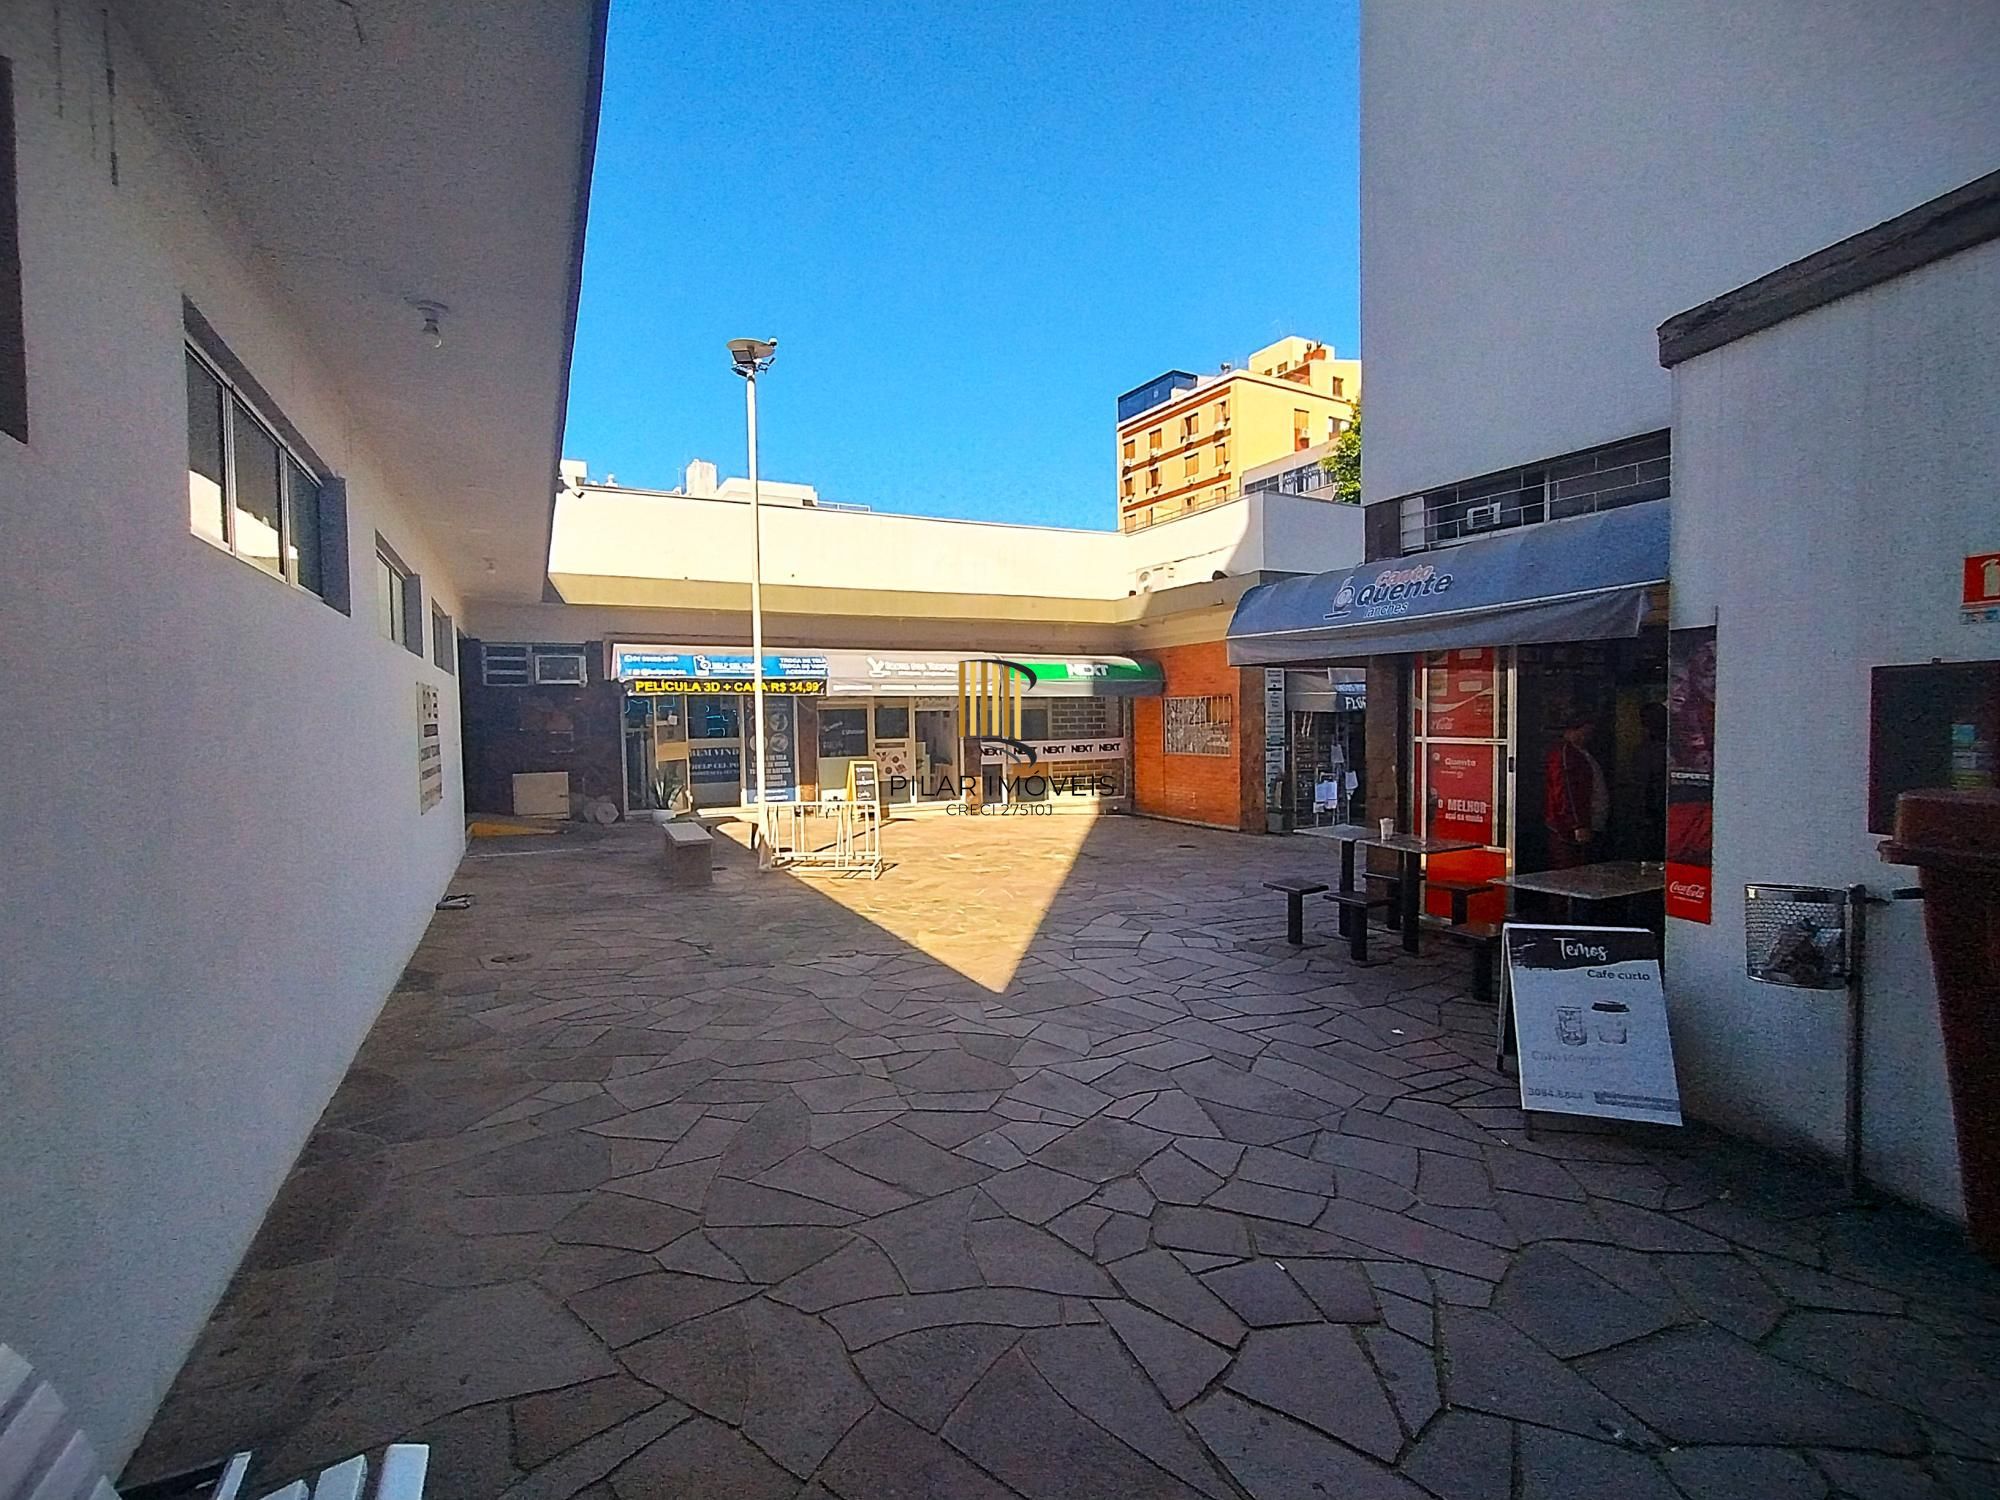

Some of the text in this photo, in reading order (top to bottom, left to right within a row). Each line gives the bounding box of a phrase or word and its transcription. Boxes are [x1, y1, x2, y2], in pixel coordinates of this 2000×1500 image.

[1355, 574, 1453, 607] Quente
[635, 679, 701, 692] PELÍCULA
[704, 681, 720, 692] 3D
[771, 681, 787, 693] R$
[789, 681, 820, 694] 34,99
[1043, 746, 1066, 754] NEXT
[1071, 745, 1094, 753] NEXT
[1099, 743, 1121, 752] NEXT
[1447, 799, 1487, 814] MELHOR
[1553, 937, 1608, 961] Temos
